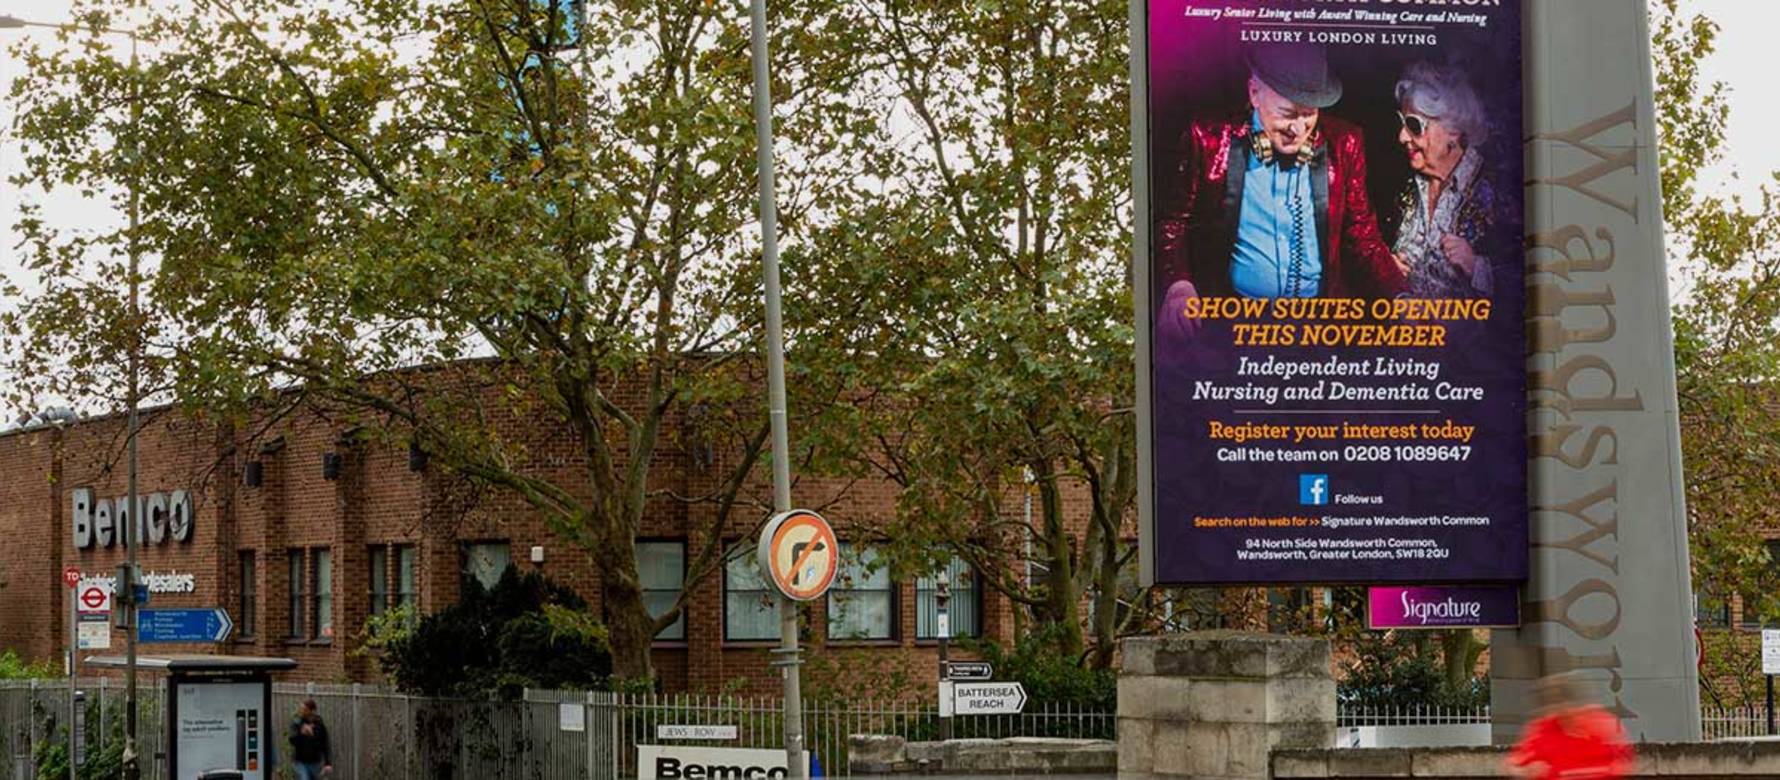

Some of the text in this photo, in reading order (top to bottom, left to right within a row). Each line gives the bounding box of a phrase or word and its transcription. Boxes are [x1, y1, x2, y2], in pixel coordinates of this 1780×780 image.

[1185, 6, 1487, 26] Luxury Senior Living with Award Winning Care and Nursing
[1241, 30, 1437, 45] LUXURY LONDON LIVING
[1184, 297, 1491, 320] SHOW SUITES OPENING
[1232, 324, 1446, 346] THIS NOVEMBER
[1237, 355, 1440, 380] Independent Living
[1192, 380, 1484, 404] Nursing and Dementia Care
[1209, 419, 1475, 442] Register your interest today
[1217, 445, 1472, 461] Call the team on 0208 1089647
[1335, 494, 1383, 504] Follow us
[1194, 516, 1232, 527] Search
[1233, 518, 1247, 527] on
[1249, 516, 1267, 527] the
[1268, 516, 1290, 527] web
[1292, 516, 1307, 527] for
[1321, 515, 1373, 529] Signature
[1373, 515, 1441, 526] Wandsworth
[1442, 515, 1490, 526] Common
[1245, 538, 1437, 549] 94 North Side Wandsworth Common,
[1237, 549, 1449, 561] Wandsworth, Greater London, SW18 2QU
[1401, 590, 1480, 624] Signature
[958, 688, 1016, 698] BATTERSEA
[969, 699, 1004, 709] REACH
[664, 727, 688, 737] JEWS
[695, 727, 715, 738] ROW
[656, 757, 789, 780] Bemco
